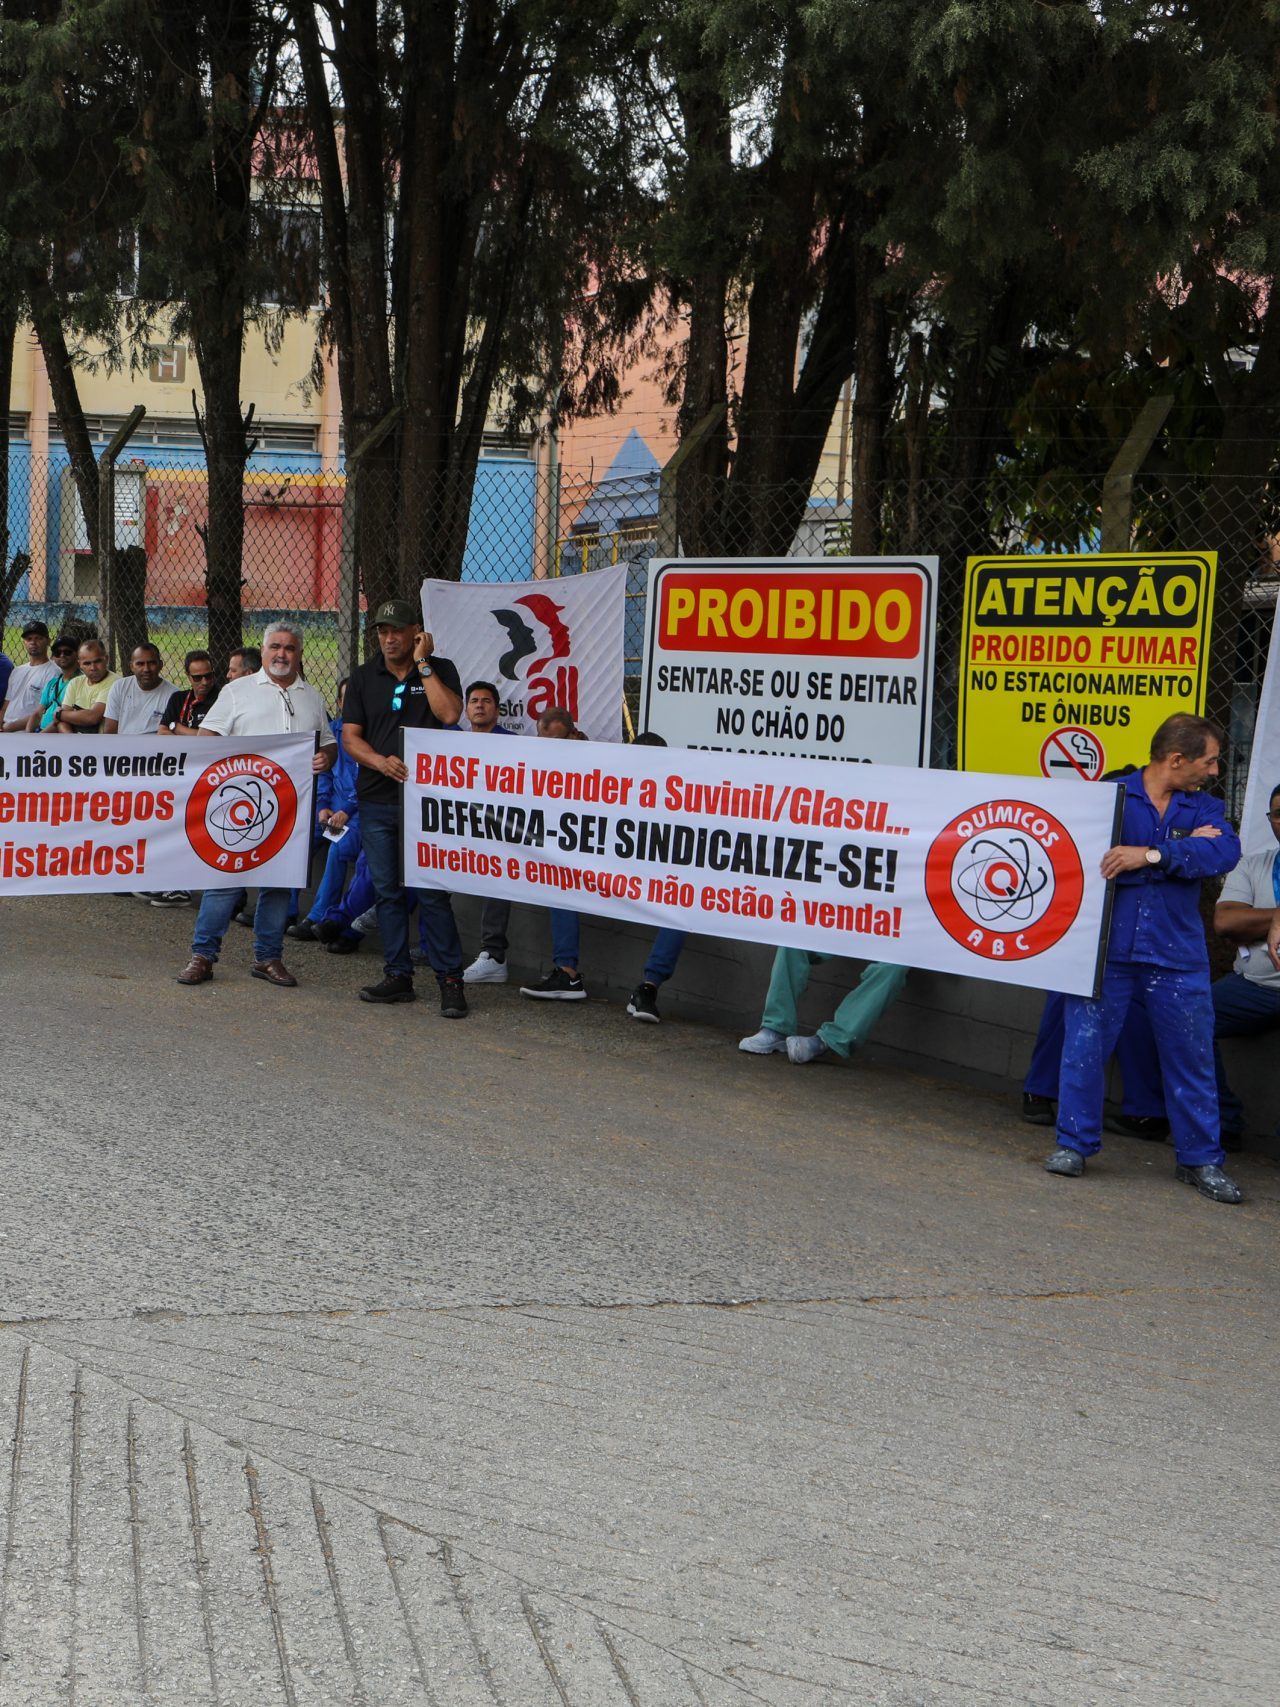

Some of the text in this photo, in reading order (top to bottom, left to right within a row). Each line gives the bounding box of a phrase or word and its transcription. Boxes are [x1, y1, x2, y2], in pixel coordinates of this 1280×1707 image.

[666, 588, 912, 643] PROIBIDO
[977, 567, 1198, 627] ATENÇÃO
[971, 634, 1198, 665] PROIBIDO FUMAR
[657, 665, 918, 705] SENTAR-SE OU SE DEITAR
[971, 670, 1193, 697] NO ESTACIONAMENTO
[716, 705, 845, 743] NO CHÃO DO
[1021, 698, 1131, 727] DE ÔNIBUS
[16, 750, 62, 778] não
[68, 755, 97, 777] se
[103, 752, 187, 777] vende!
[207, 758, 281, 786] QUÍMICOS
[416, 753, 910, 836] BASF vai vender a Suvinil/Glasu...
[421, 796, 898, 893] DEFENDA-SE! SINDICALIZE-SE!
[956, 803, 1060, 848] QUÍMICOS
[417, 841, 902, 938] Direitos e empregos não estão à venda!
